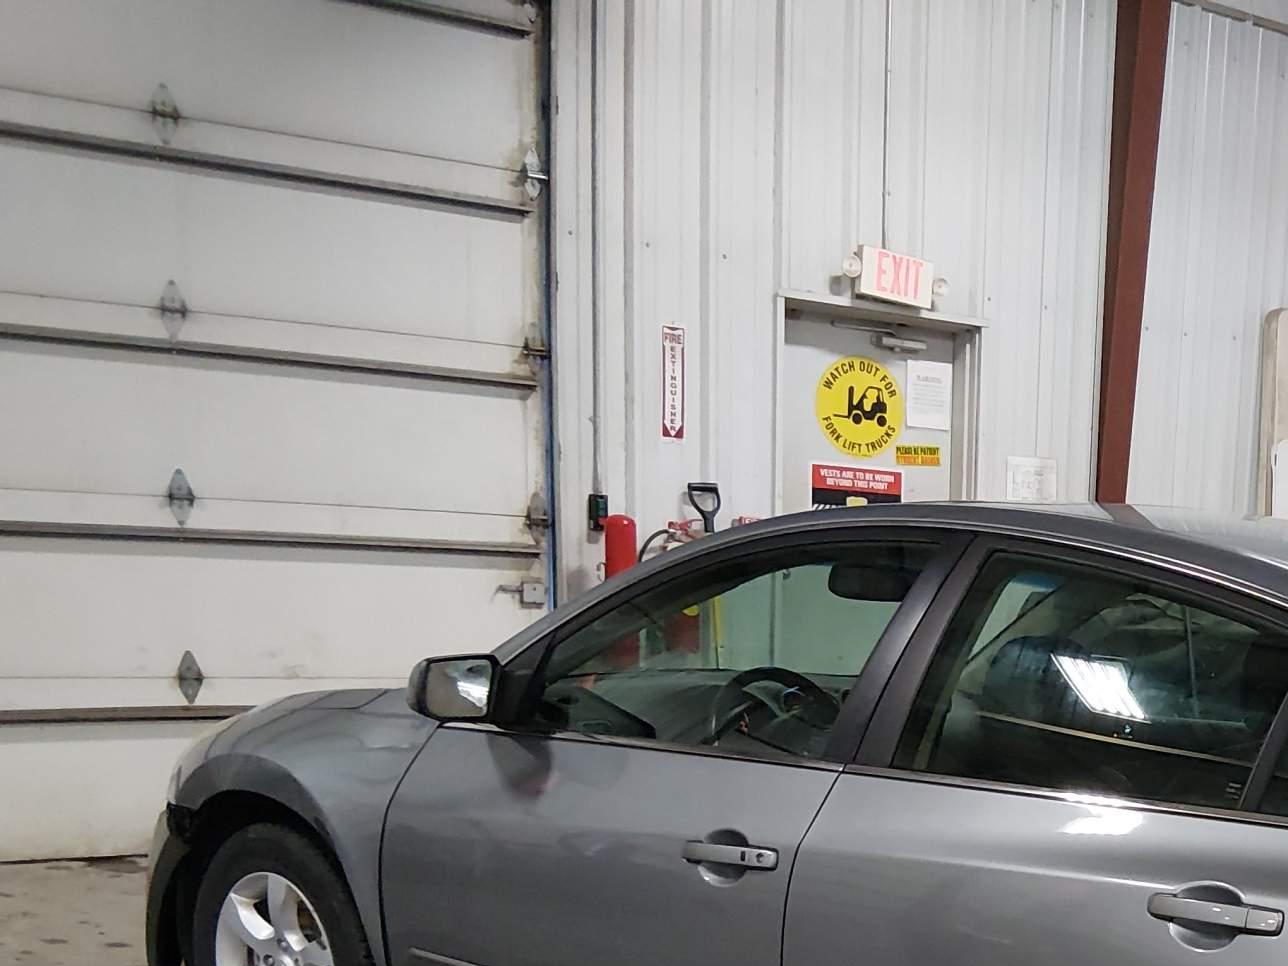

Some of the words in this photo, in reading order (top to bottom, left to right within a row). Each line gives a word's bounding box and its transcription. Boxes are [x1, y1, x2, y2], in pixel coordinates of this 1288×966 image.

[876, 250, 924, 300] EXIT
[664, 332, 683, 345] FIRE
[670, 345, 678, 432] EXTINGUISHER
[823, 360, 856, 390] WATCH
[859, 360, 881, 377] OUT
[879, 374, 897, 399] FOR
[822, 416, 843, 444] FORK
[842, 438, 863, 453] LIFT
[864, 424, 896, 453] TRUCKS
[819, 468, 841, 477] VESTS
[842, 470, 855, 479] ARE
[855, 471, 865, 480] TO
[865, 473, 874, 481] BE
[874, 473, 895, 483] WORN
[826, 477, 853, 487] BEYOND
[853, 479, 868, 489] THIS
[868, 481, 889, 491] POINT
